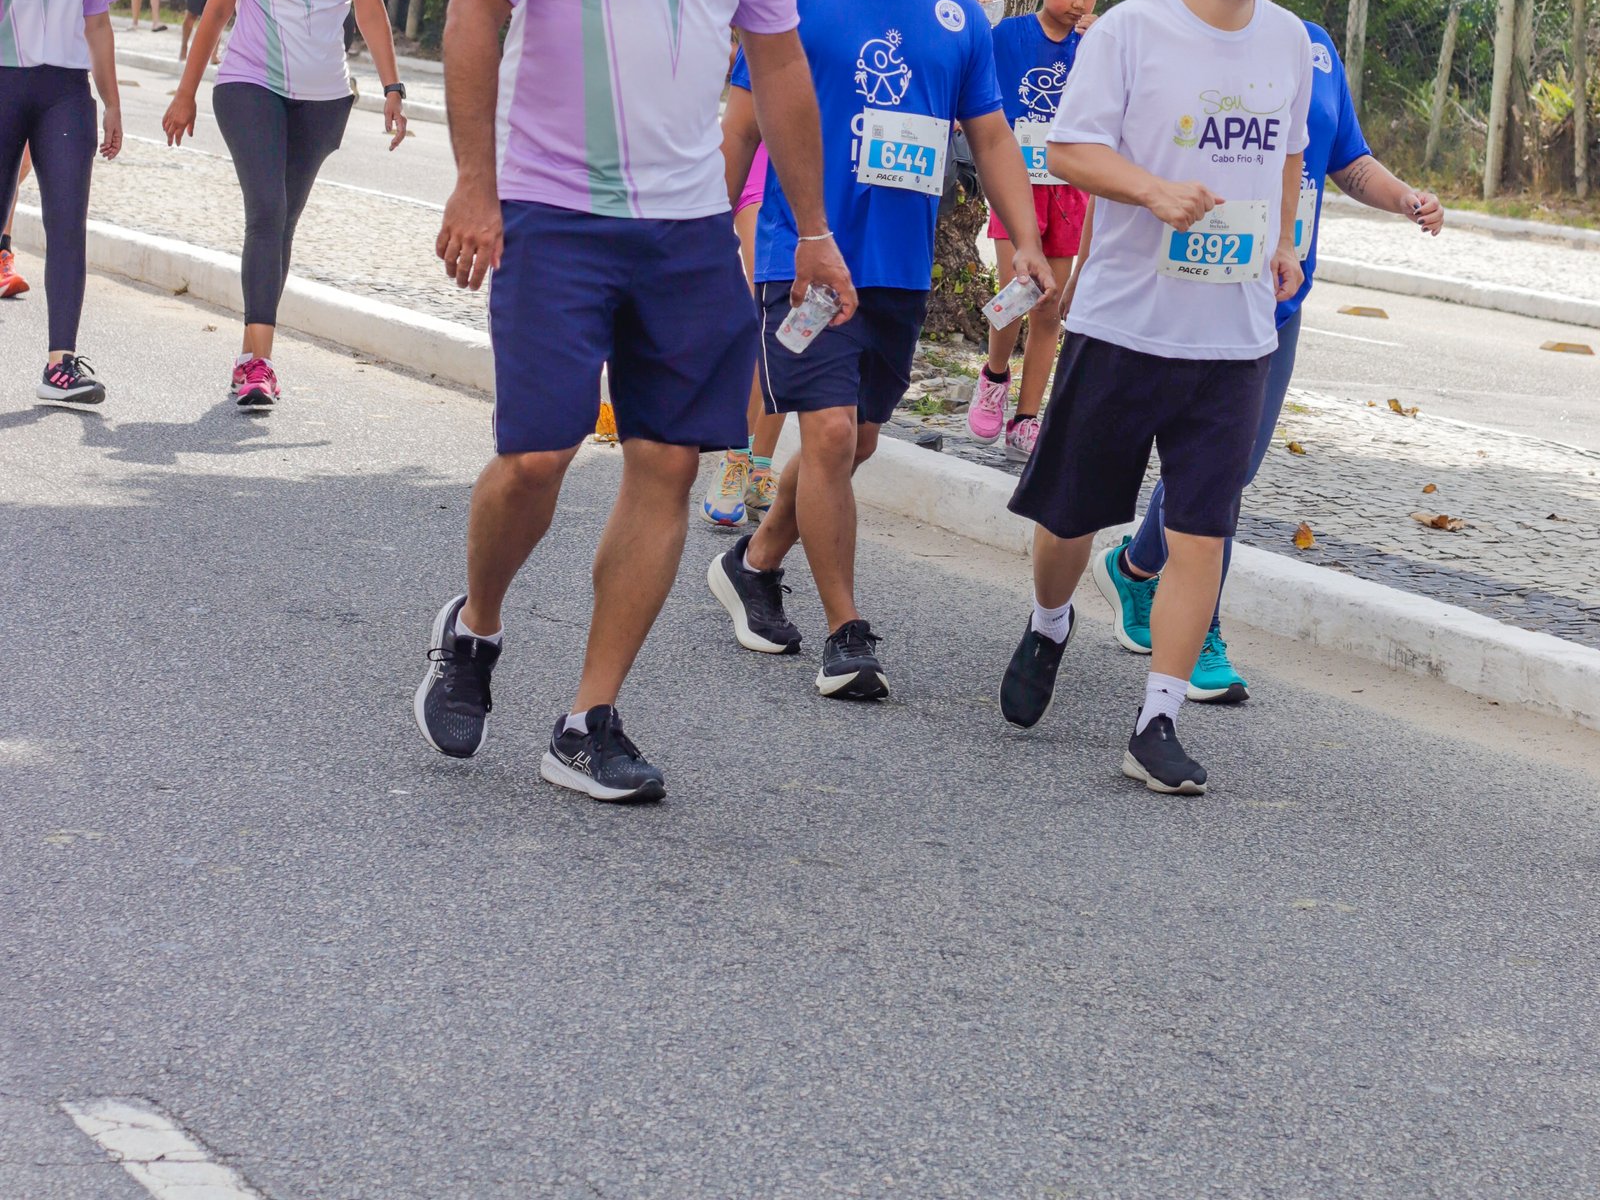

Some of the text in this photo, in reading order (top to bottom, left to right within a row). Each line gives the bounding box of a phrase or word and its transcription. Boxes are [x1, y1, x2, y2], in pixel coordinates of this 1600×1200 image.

[1028, 111, 1047, 122] Uma
[1198, 116, 1280, 151] APAE
[880, 141, 927, 174] 644
[1211, 154, 1235, 163] Cabo
[1237, 154, 1253, 163] Frio
[876, 173, 898, 182] PACE
[1185, 233, 1241, 264] 892
[1178, 266, 1203, 275] PACE
